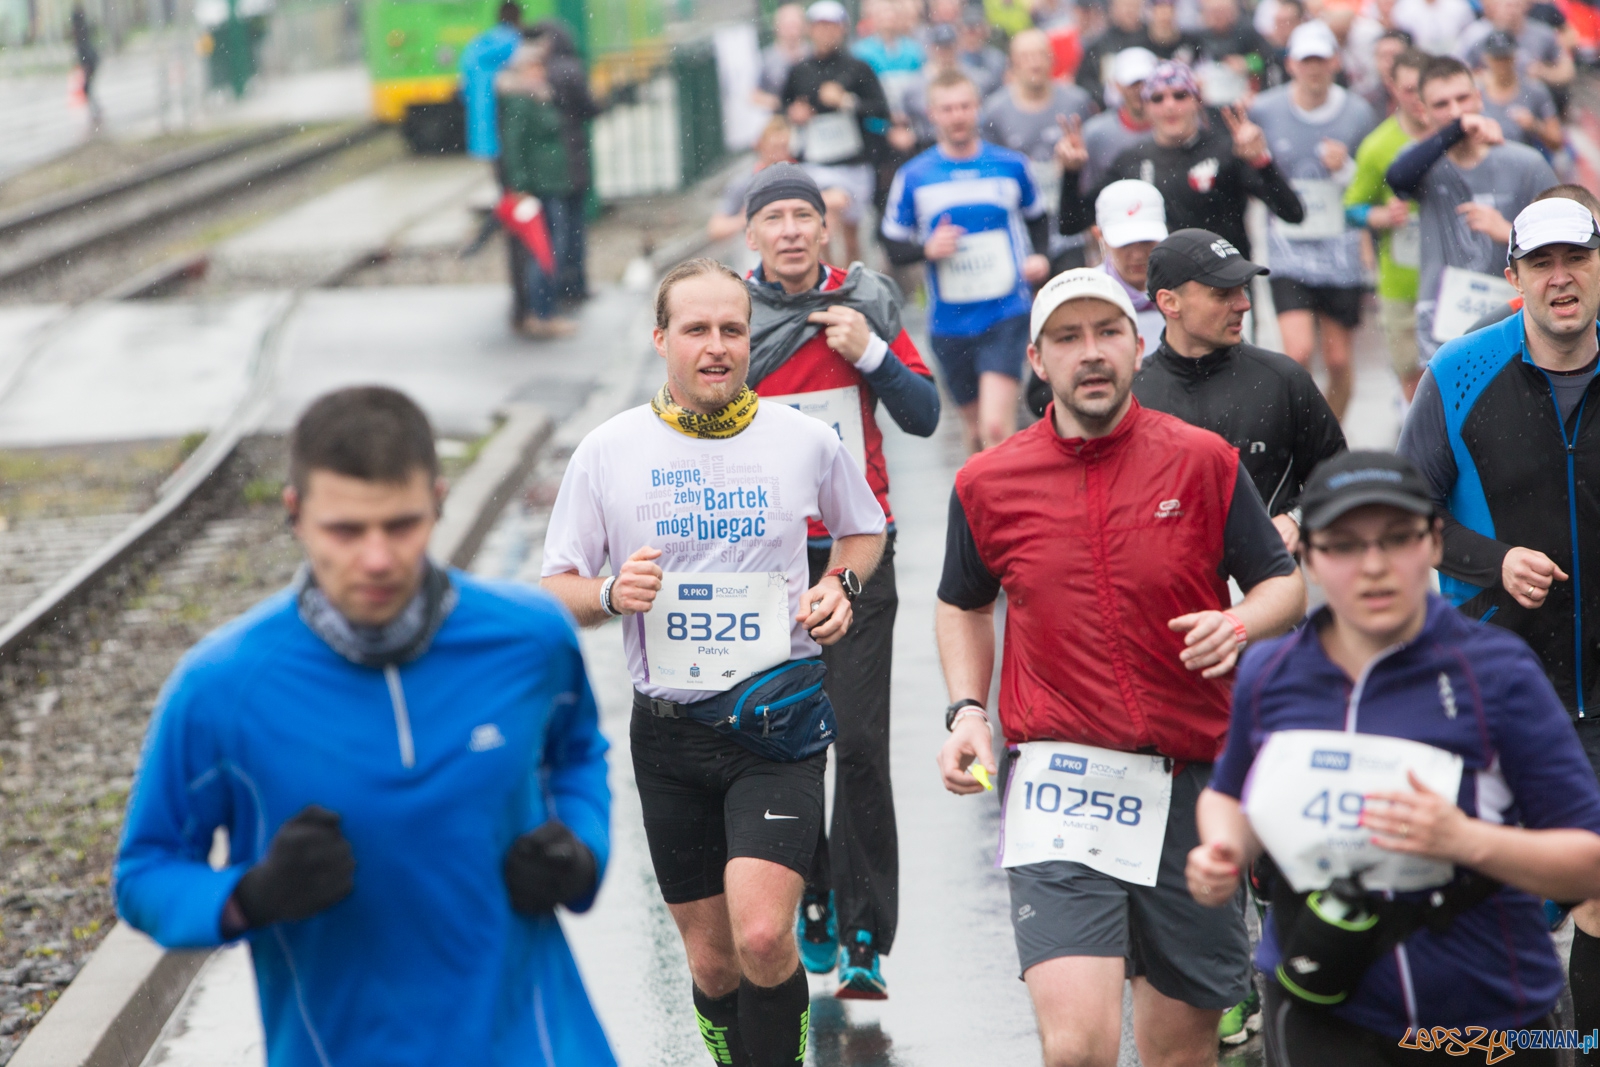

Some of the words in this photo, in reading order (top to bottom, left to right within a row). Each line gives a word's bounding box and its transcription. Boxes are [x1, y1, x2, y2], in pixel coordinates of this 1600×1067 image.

[669, 458, 697, 470] wiara
[699, 453, 710, 478] walka
[710, 455, 726, 488] duma
[726, 463, 763, 474] uśmiech
[651, 468, 706, 488] Biegnę,
[726, 475, 769, 485] zwycięstwo
[645, 487, 672, 500] radość
[673, 488, 702, 506] żeby
[703, 485, 769, 511] Bartek
[636, 500, 672, 522] moc
[767, 510, 794, 522] miłość
[656, 512, 694, 538] mógł
[697, 510, 766, 544] biegać
[664, 537, 696, 556] sport
[741, 537, 783, 550] motywacja
[720, 546, 745, 564] siła
[666, 612, 761, 642] 8326
[697, 646, 730, 657] Patryk
[1024, 781, 1143, 826] 10258
[1062, 819, 1100, 833] Marcin
